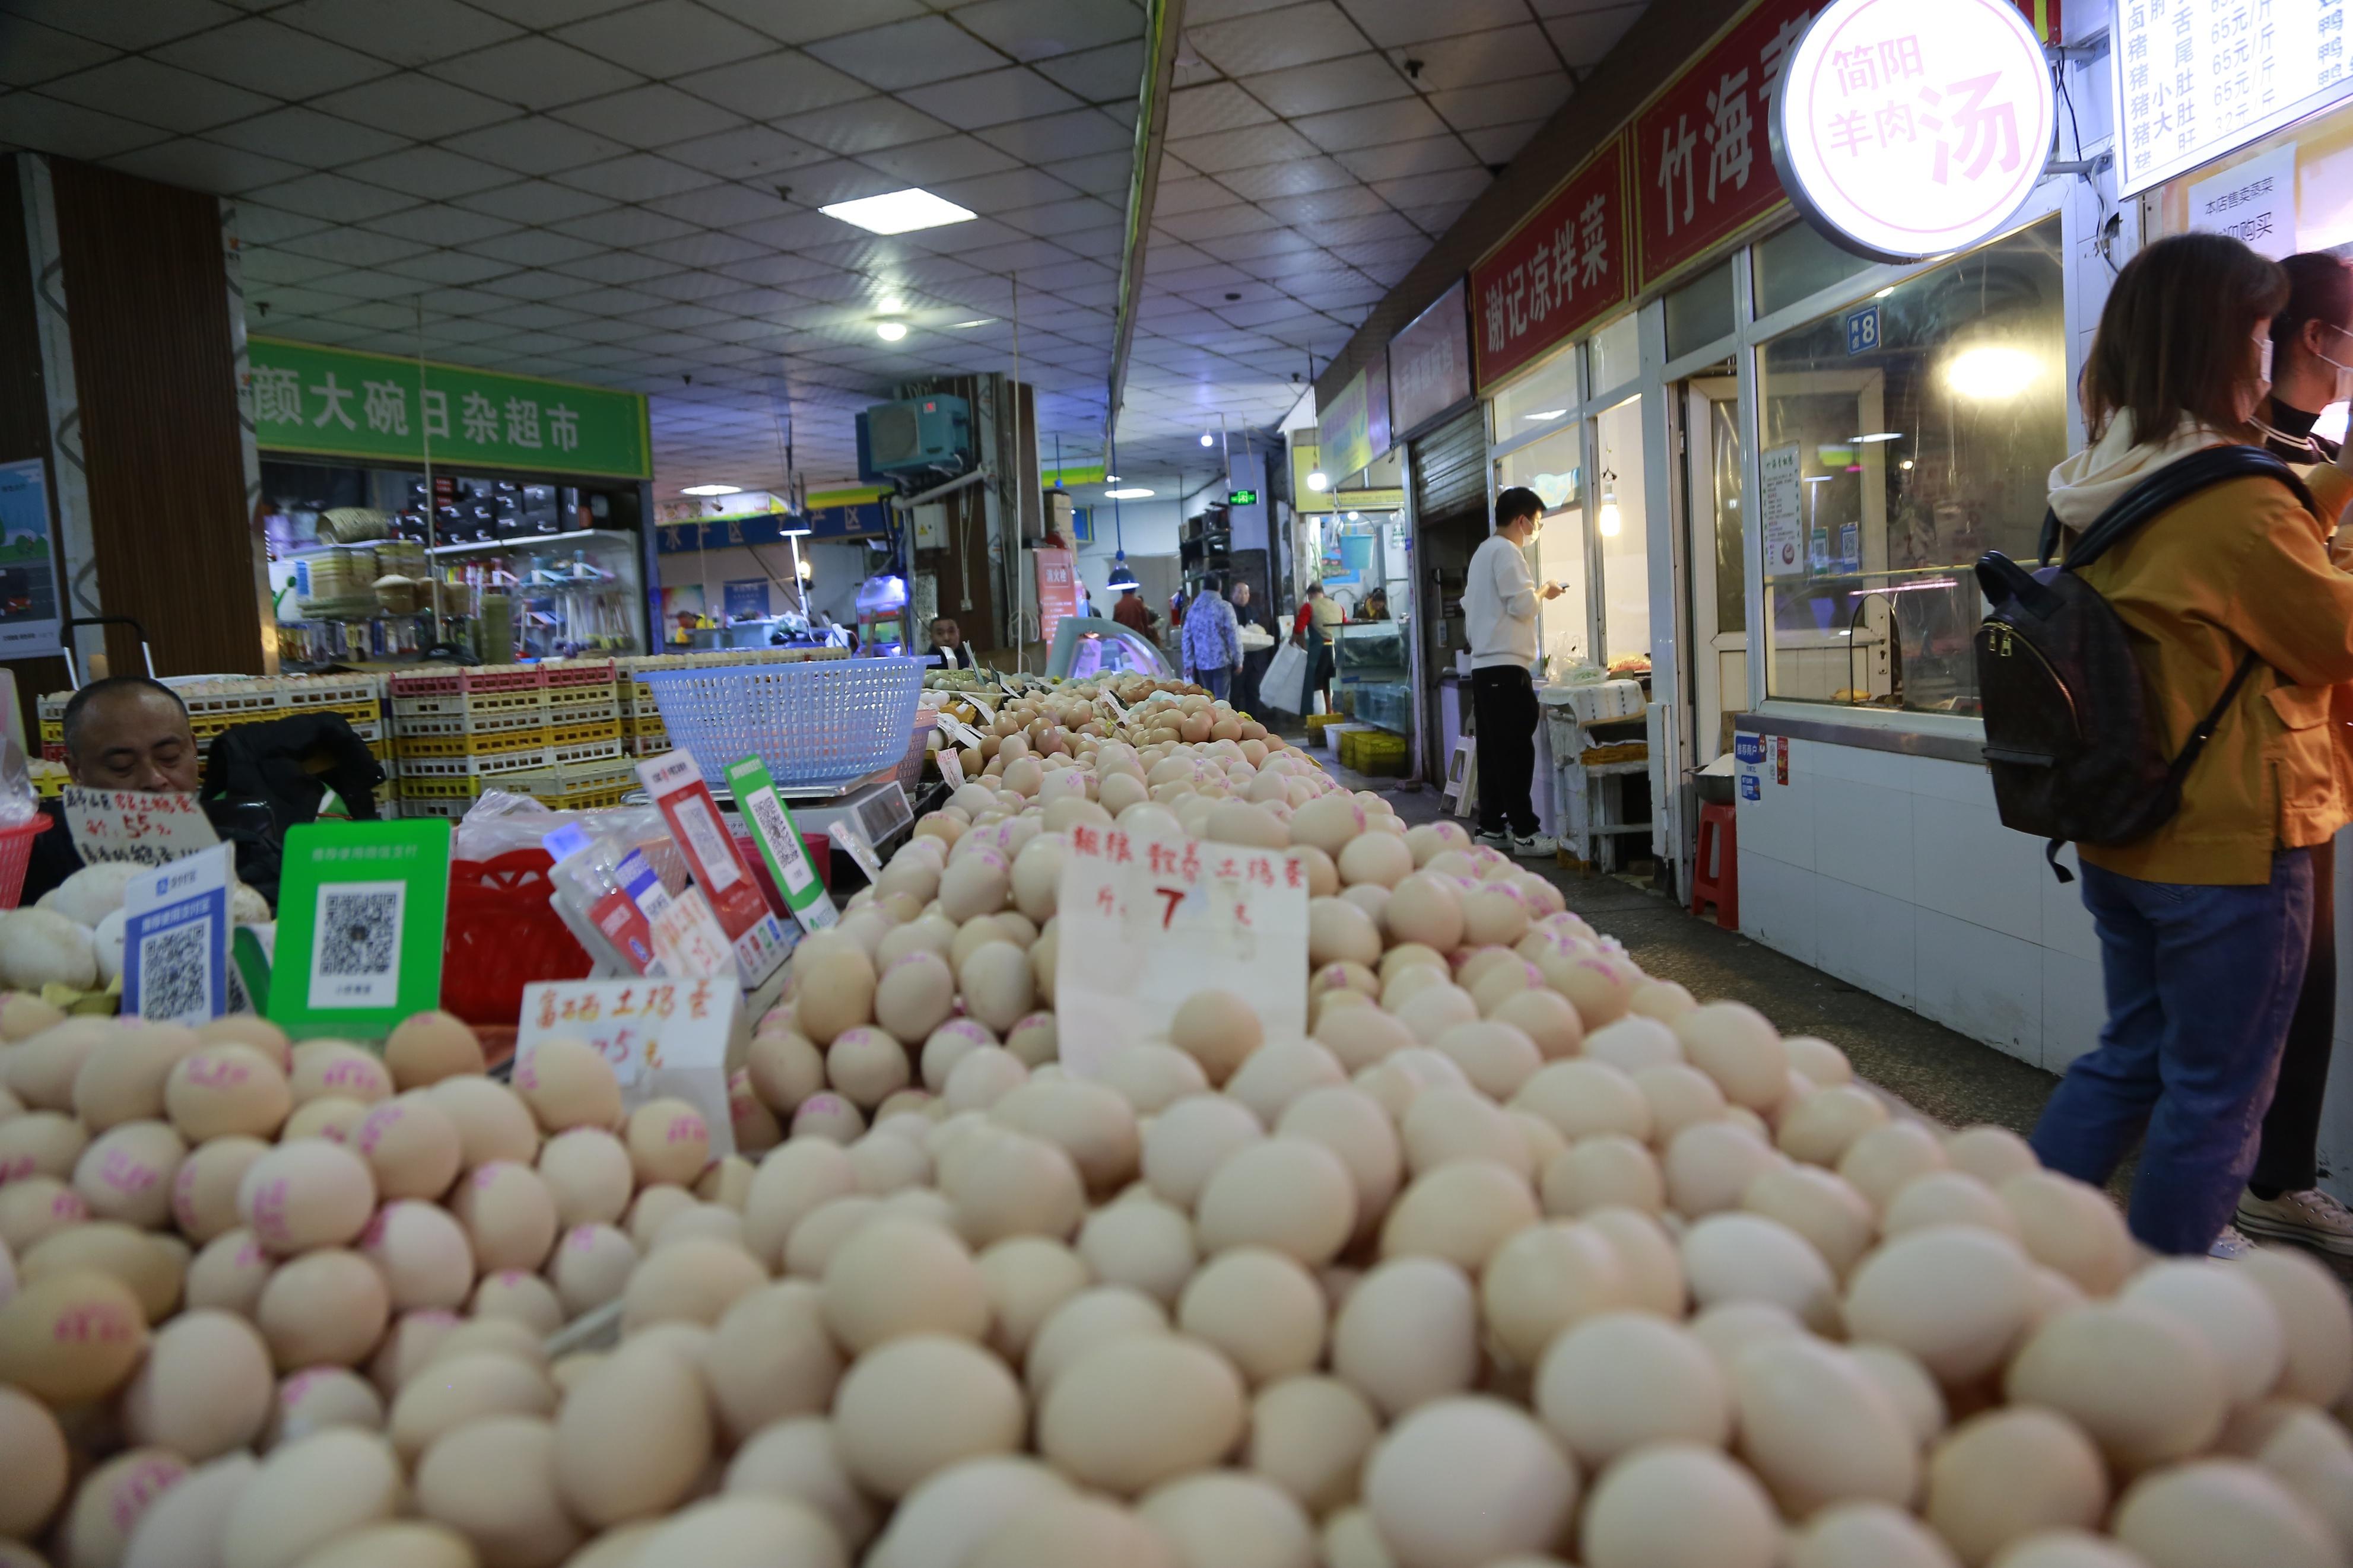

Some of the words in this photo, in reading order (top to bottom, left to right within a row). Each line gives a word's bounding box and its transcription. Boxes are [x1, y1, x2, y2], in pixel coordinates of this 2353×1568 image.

[1832, 34, 1924, 97] 简阳
[2212, 23, 2275, 75] 65元/斤
[2214, 56, 2275, 106] 65元/斤
[2205, 177, 2273, 216] 本店售卖蒸菜
[1485, 194, 1608, 352] 谢记凉拌菜
[1862, 315, 1875, 344] 8
[250, 364, 579, 452] 颜大碗日杂超市
